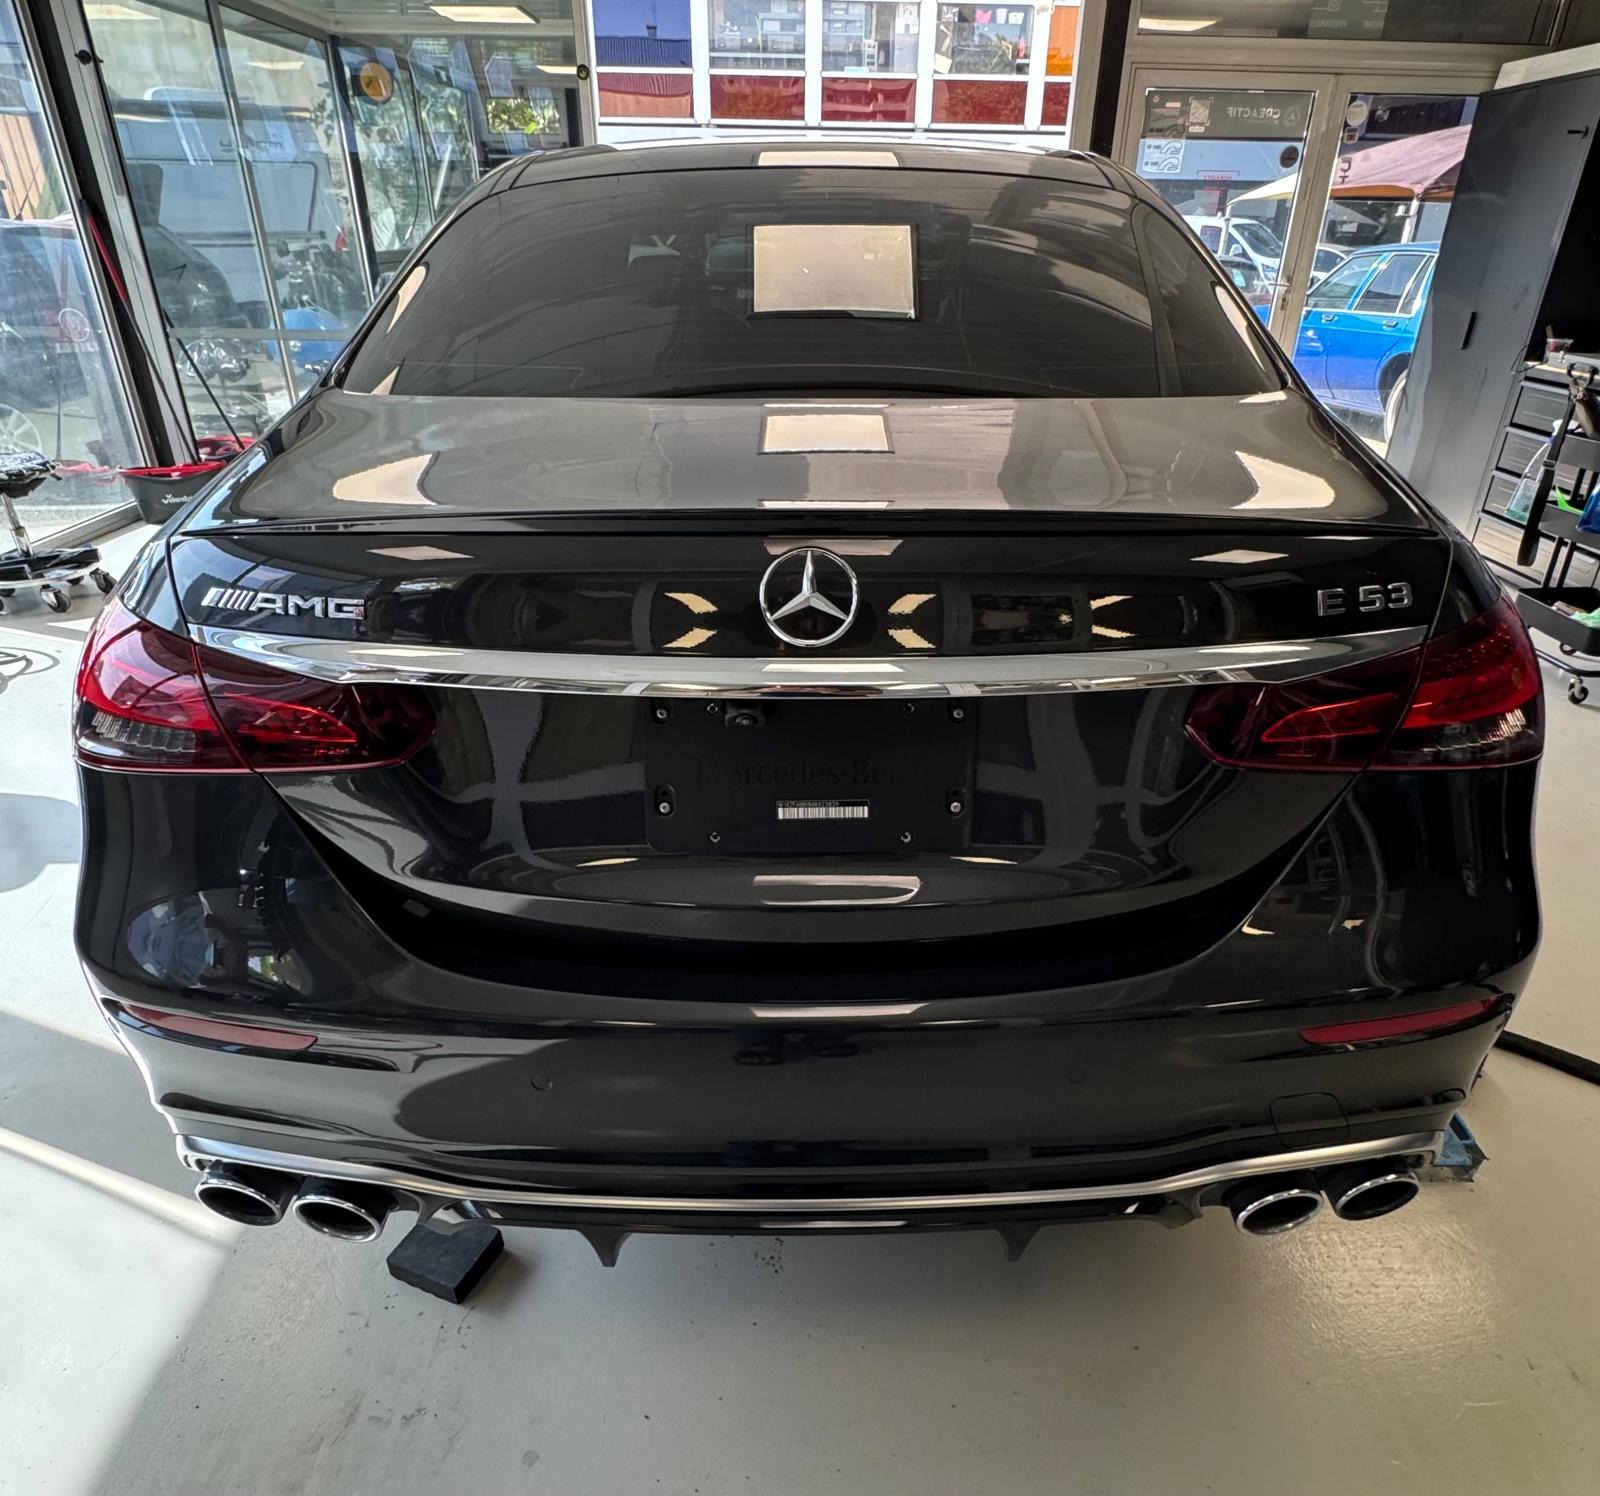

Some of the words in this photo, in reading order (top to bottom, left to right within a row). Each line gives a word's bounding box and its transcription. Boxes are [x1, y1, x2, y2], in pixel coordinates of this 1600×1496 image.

[246, 590, 365, 620] AMG
[1317, 588, 1346, 617] E
[1358, 582, 1413, 612] 53
[698, 757, 923, 785] Mercedes-Benz
